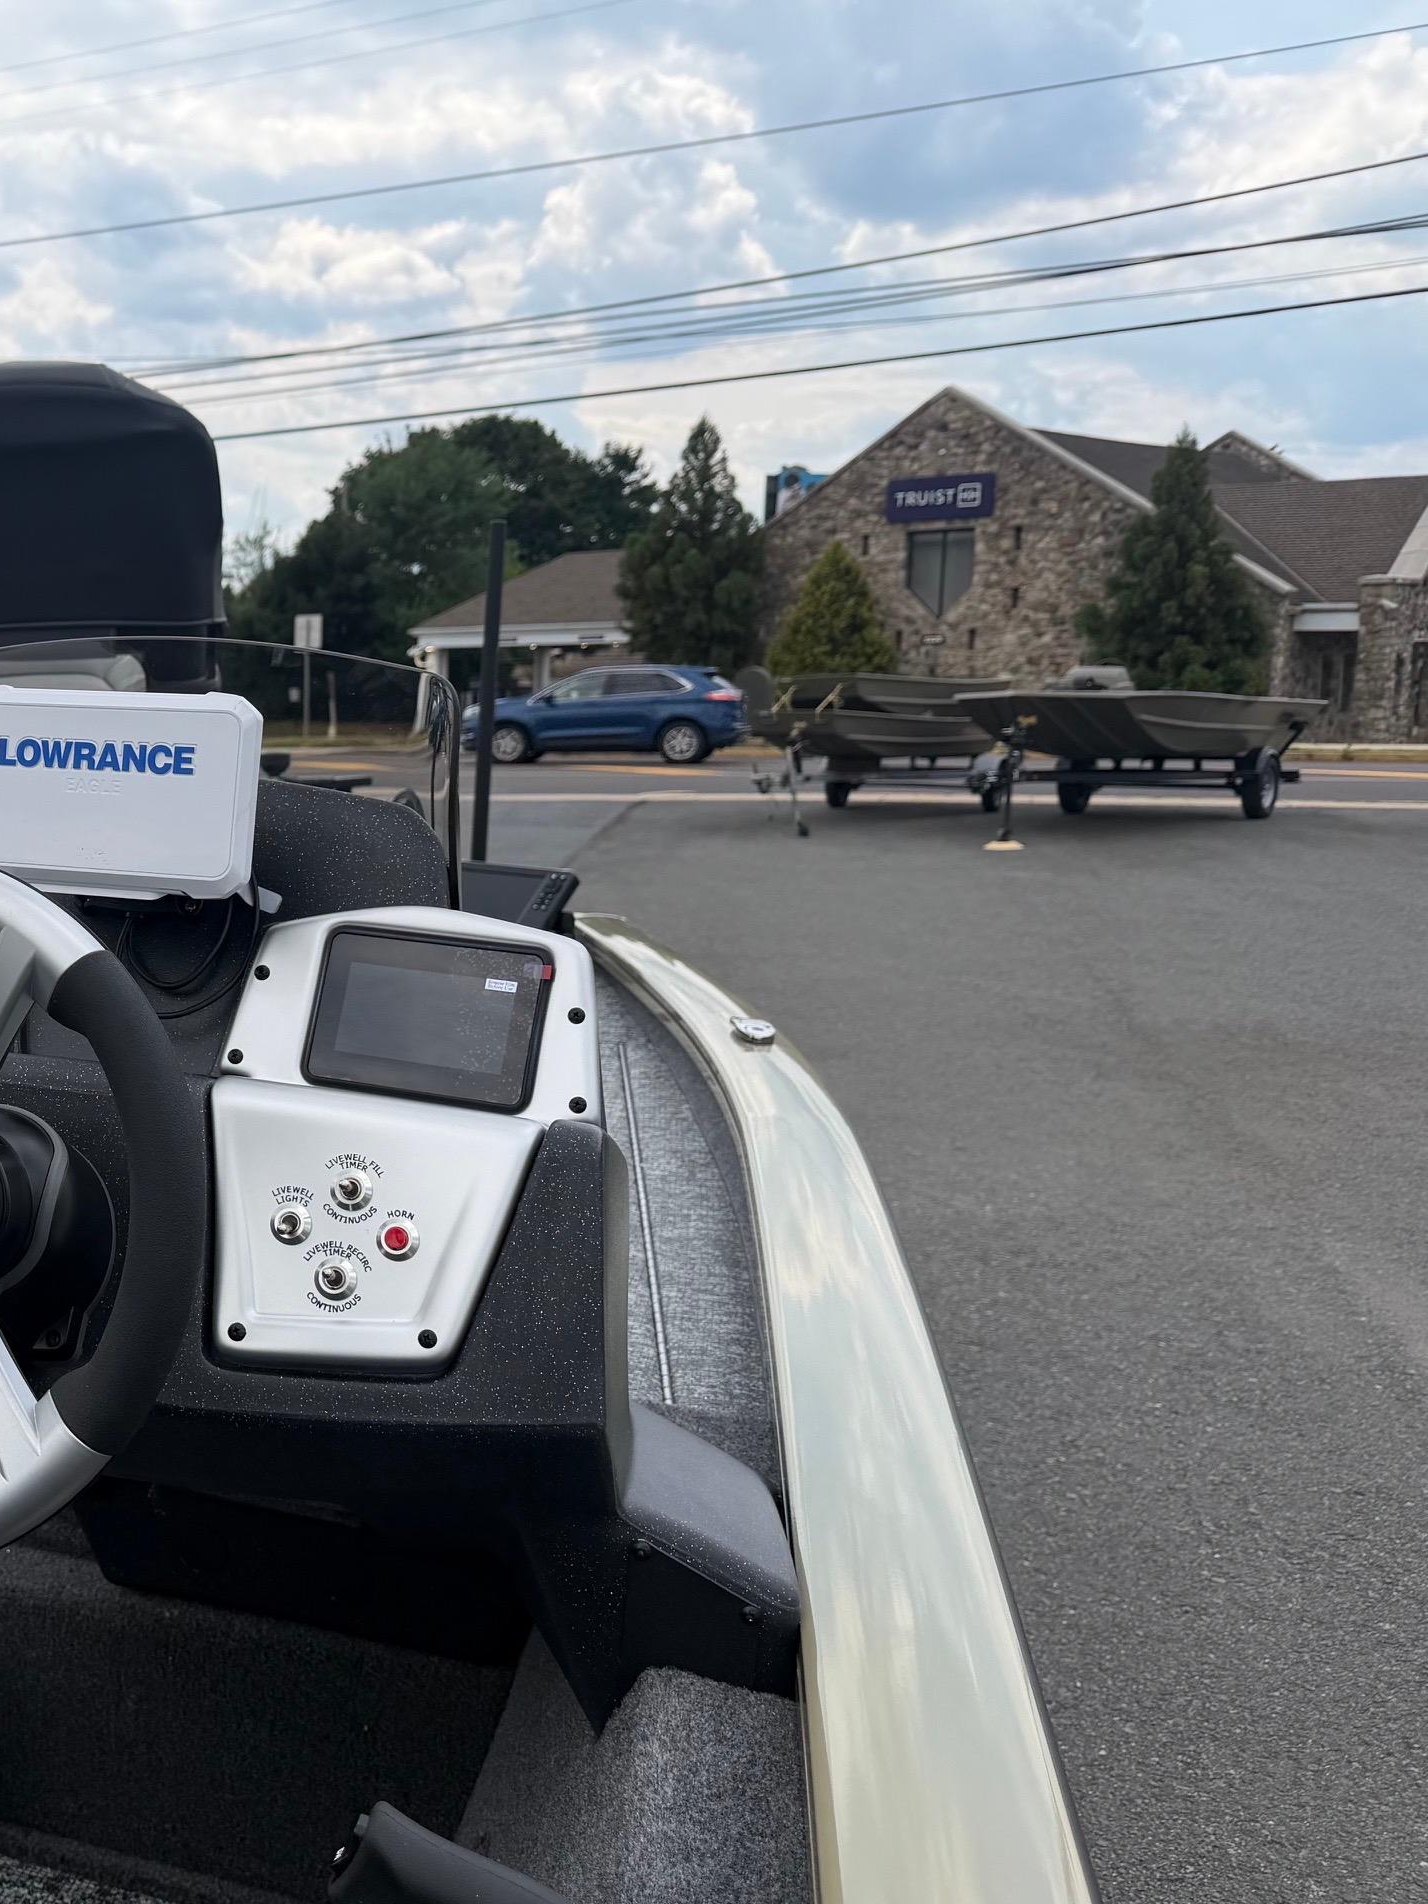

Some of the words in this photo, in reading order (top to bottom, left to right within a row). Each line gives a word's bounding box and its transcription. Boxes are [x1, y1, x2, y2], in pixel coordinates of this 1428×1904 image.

[894, 487, 956, 509] TRUIST
[66, 777, 122, 794] EAGLE
[325, 1153, 367, 1170] LIVEWELL
[368, 1160, 385, 1178] FILL
[338, 1161, 369, 1173] TIMER
[271, 1185, 314, 1200] LIVEWELL
[275, 1194, 310, 1208] LIGHTS
[322, 1203, 378, 1224] CONTINUOUS
[387, 1209, 415, 1221] HORN
[303, 1240, 344, 1262] LIVEWELL
[346, 1243, 372, 1273] RECIRC
[323, 1249, 353, 1261] TIMER
[306, 1291, 362, 1313] CONTINUOUS
